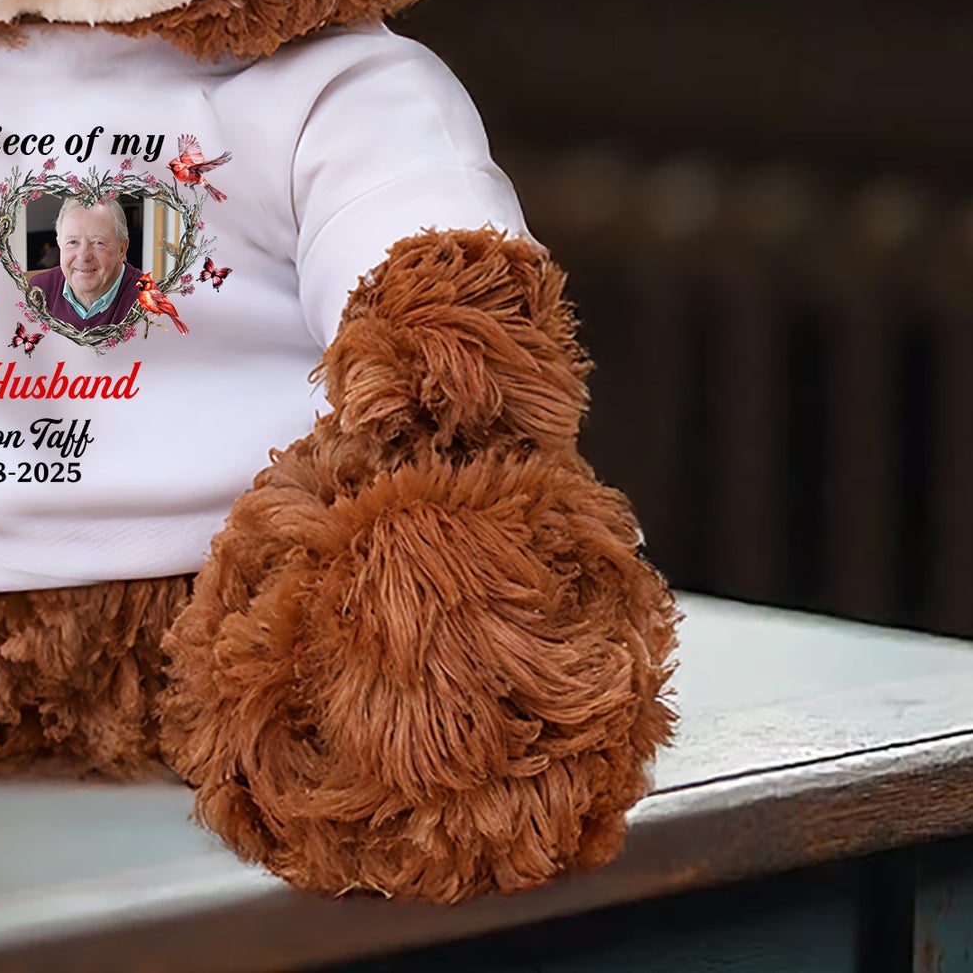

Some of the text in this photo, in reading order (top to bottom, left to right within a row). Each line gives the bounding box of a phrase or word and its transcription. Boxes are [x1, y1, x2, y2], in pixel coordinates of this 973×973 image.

[64, 125, 105, 163] of
[110, 134, 166, 162] my
[29, 417, 95, 459] Taff
